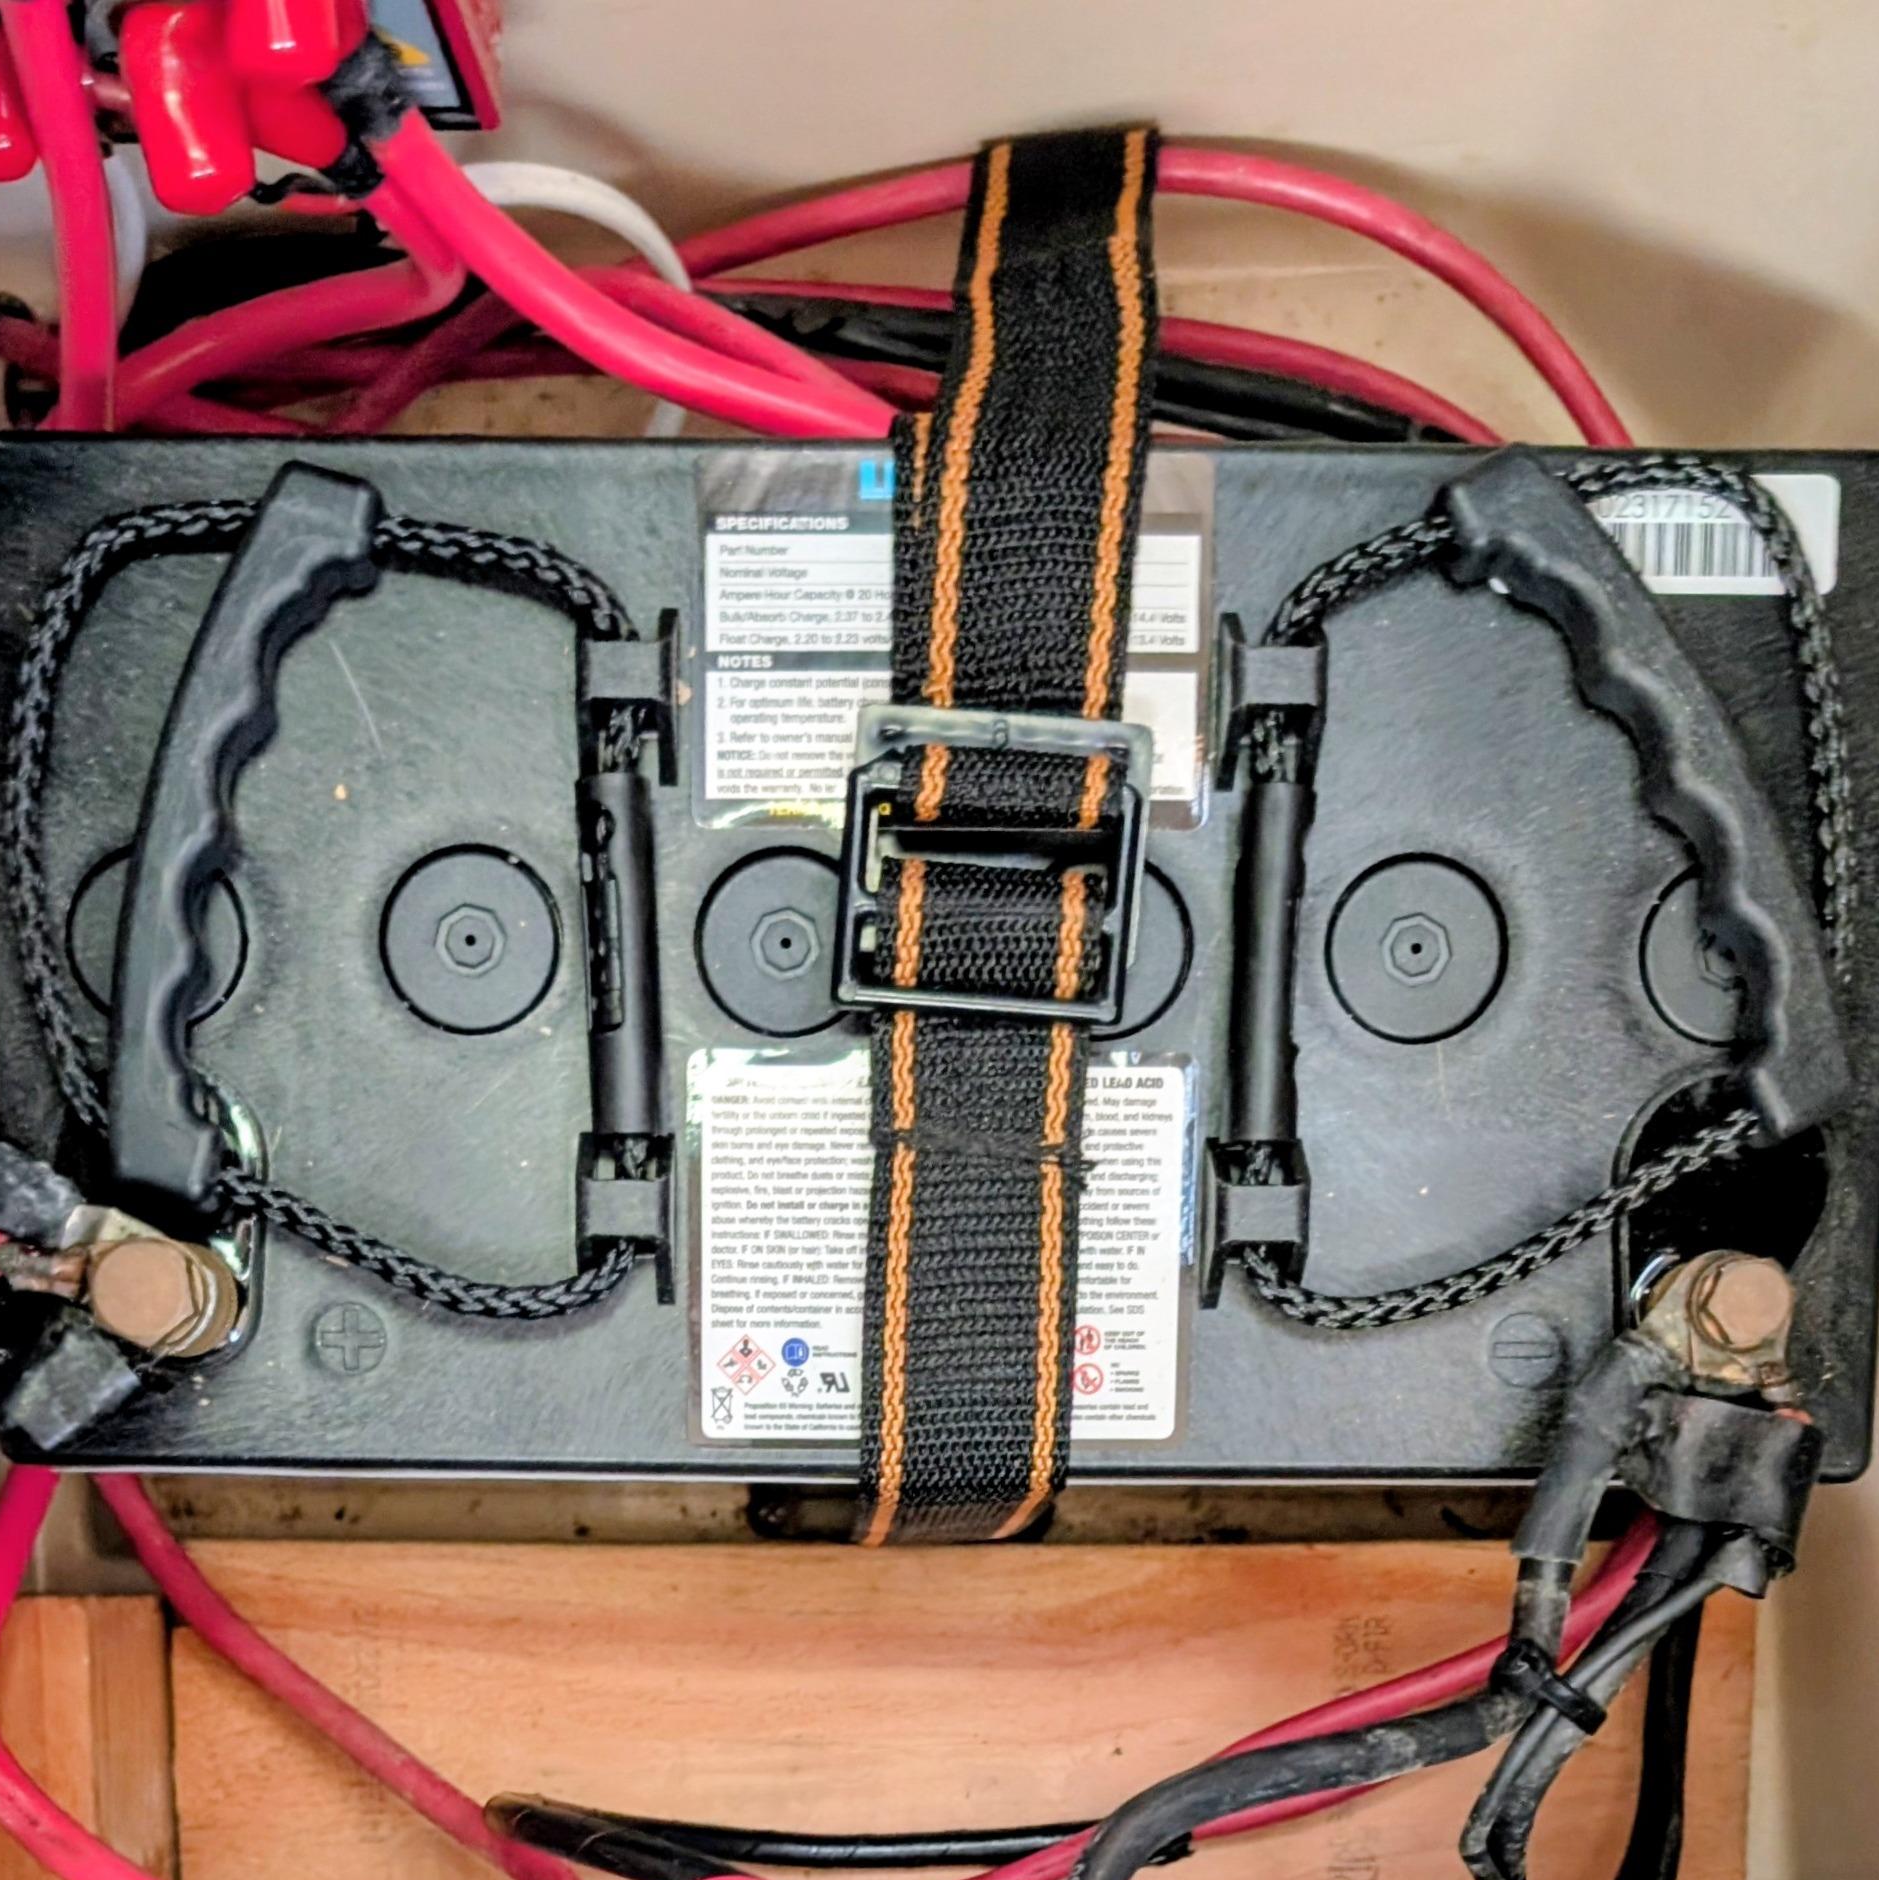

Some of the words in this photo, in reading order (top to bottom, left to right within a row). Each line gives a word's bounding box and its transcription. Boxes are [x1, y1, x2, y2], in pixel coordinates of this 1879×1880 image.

[716, 516, 850, 531] SPECIFICATIONS
[745, 544, 789, 555] Number
[768, 567, 808, 580] Voltage
[720, 590, 762, 602] Ampere
[764, 590, 791, 600] Hour
[794, 590, 841, 602] Capacity
[717, 655, 772, 668] NOTES
[729, 678, 766, 690] Charge
[769, 678, 812, 688] constant
[816, 677, 859, 691] potential
[729, 697, 745, 707] For
[749, 697, 794, 710] optimum
[818, 697, 854, 710] battery
[730, 714, 778, 725] operating
[781, 714, 846, 726] temperature.
[729, 733, 756, 743] Refer
[760, 733, 769, 743] to
[772, 733, 812, 743] owner's
[815, 733, 852, 743] manual
[1136, 1077, 1164, 1089] ACID
